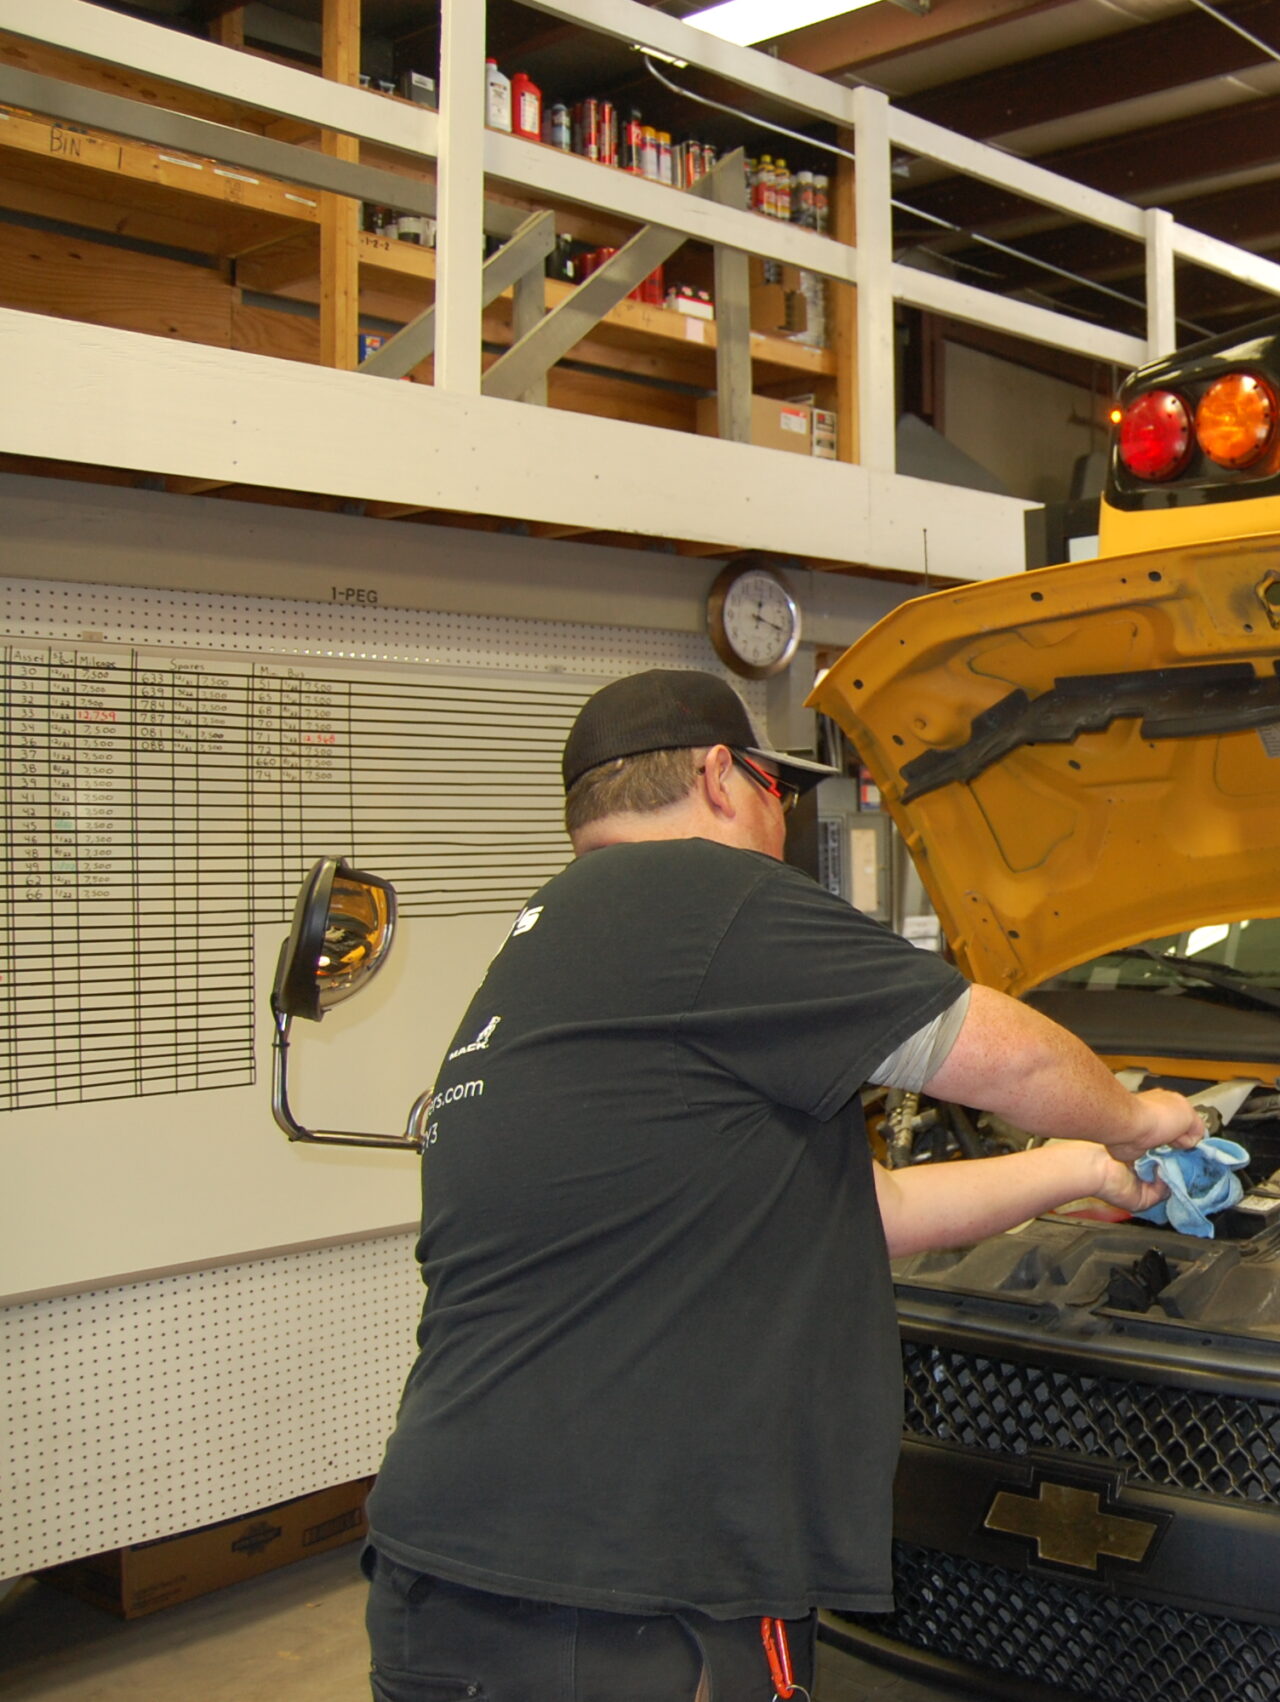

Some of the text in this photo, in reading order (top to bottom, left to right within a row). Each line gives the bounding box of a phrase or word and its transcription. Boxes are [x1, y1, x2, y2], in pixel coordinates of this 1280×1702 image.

[50, 127, 81, 157] BIN
[332, 586, 378, 603] 1-PEG
[14, 650, 45, 663] Asset
[169, 657, 205, 671] Spares
[21, 667, 37, 677] 30
[141, 673, 164, 685] 633
[21, 681, 34, 690] 31
[141, 687, 164, 698] 639
[21, 695, 34, 705] 32
[141, 700, 165, 711] 784
[22, 708, 34, 718] 33
[78, 710, 117, 722] 12,759
[140, 714, 165, 723] 787
[140, 727, 163, 738] 081
[21, 749, 37, 759] 37
[21, 763, 37, 774] 38
[21, 778, 37, 788] 39
[22, 806, 36, 816] 42
[449, 1041, 488, 1061] MACK
